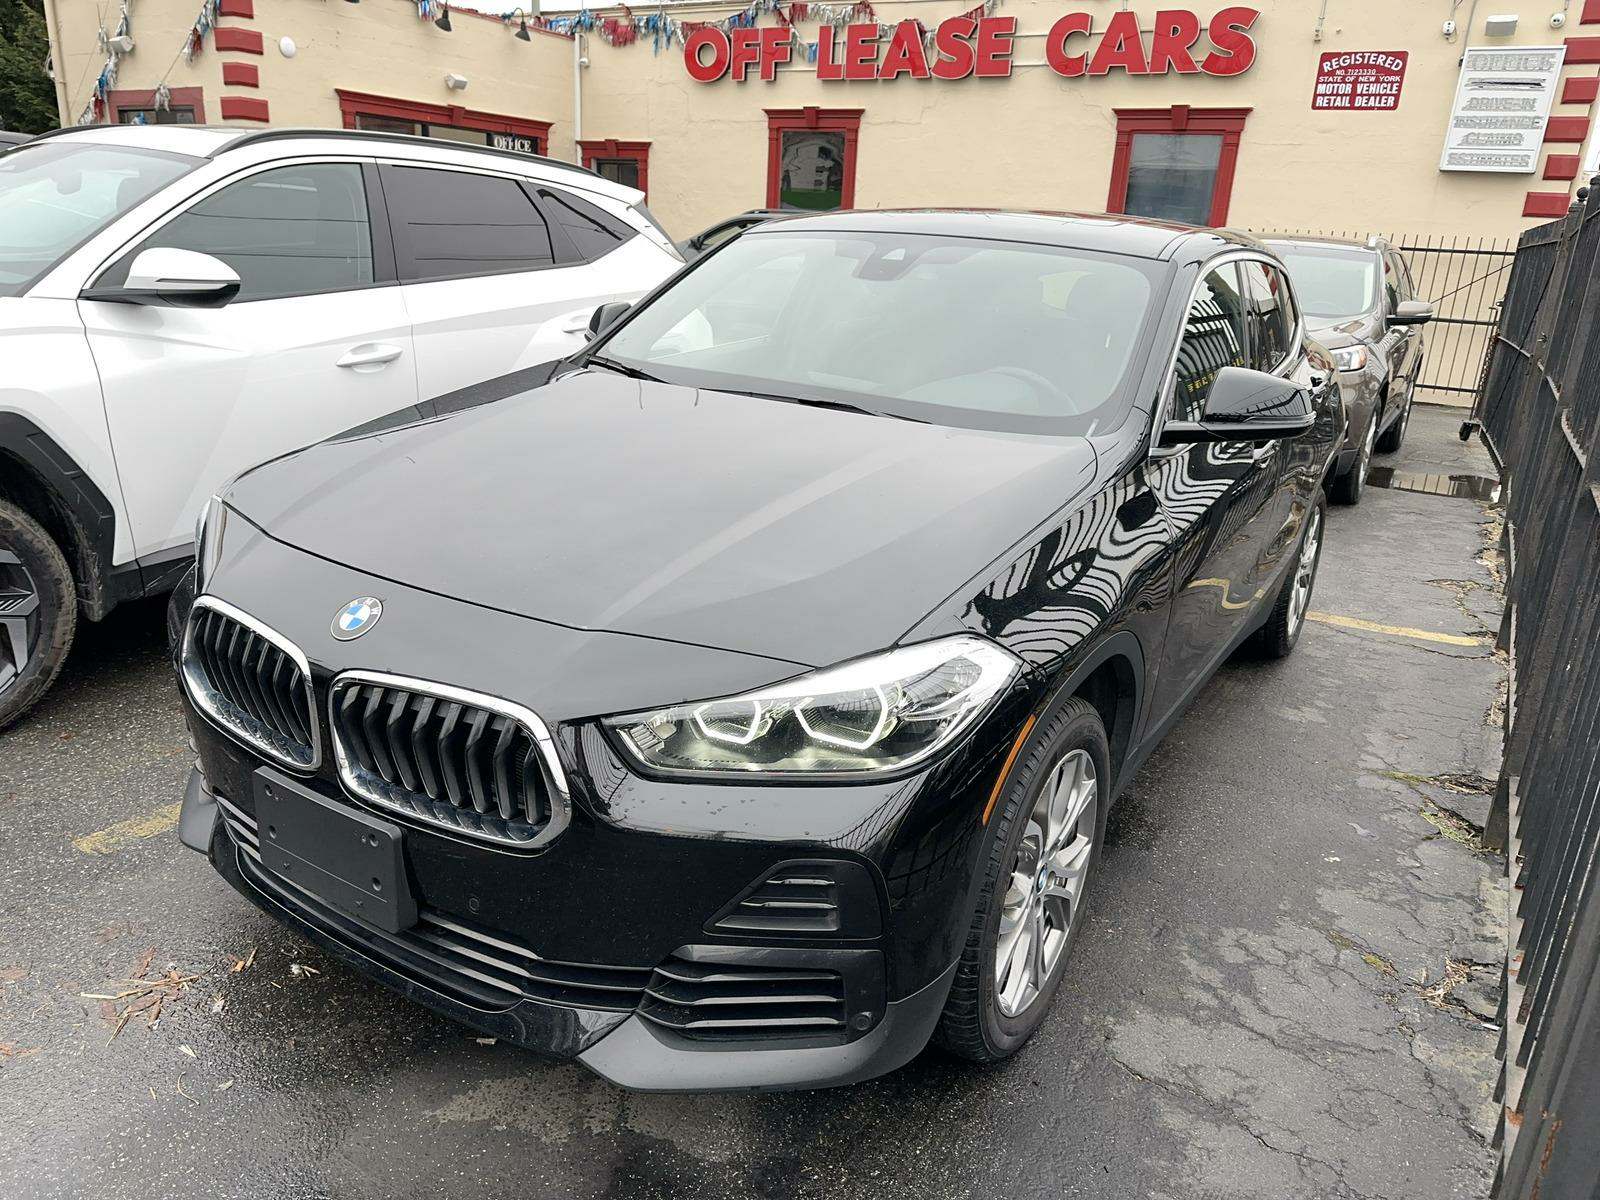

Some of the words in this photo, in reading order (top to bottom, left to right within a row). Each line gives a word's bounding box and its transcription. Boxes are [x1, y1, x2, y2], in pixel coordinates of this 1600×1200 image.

[684, 26, 793, 83] OFF
[816, 16, 1017, 81] LEASE
[1045, 7, 1262, 78] CARS
[1323, 52, 1403, 72] REGISTERED
[1316, 83, 1352, 95] MOTOR
[1356, 83, 1400, 94] VEHICLE
[1315, 95, 1351, 107] RETAIL
[1354, 95, 1395, 107] DEALER
[494, 136, 531, 152] OFFICE
